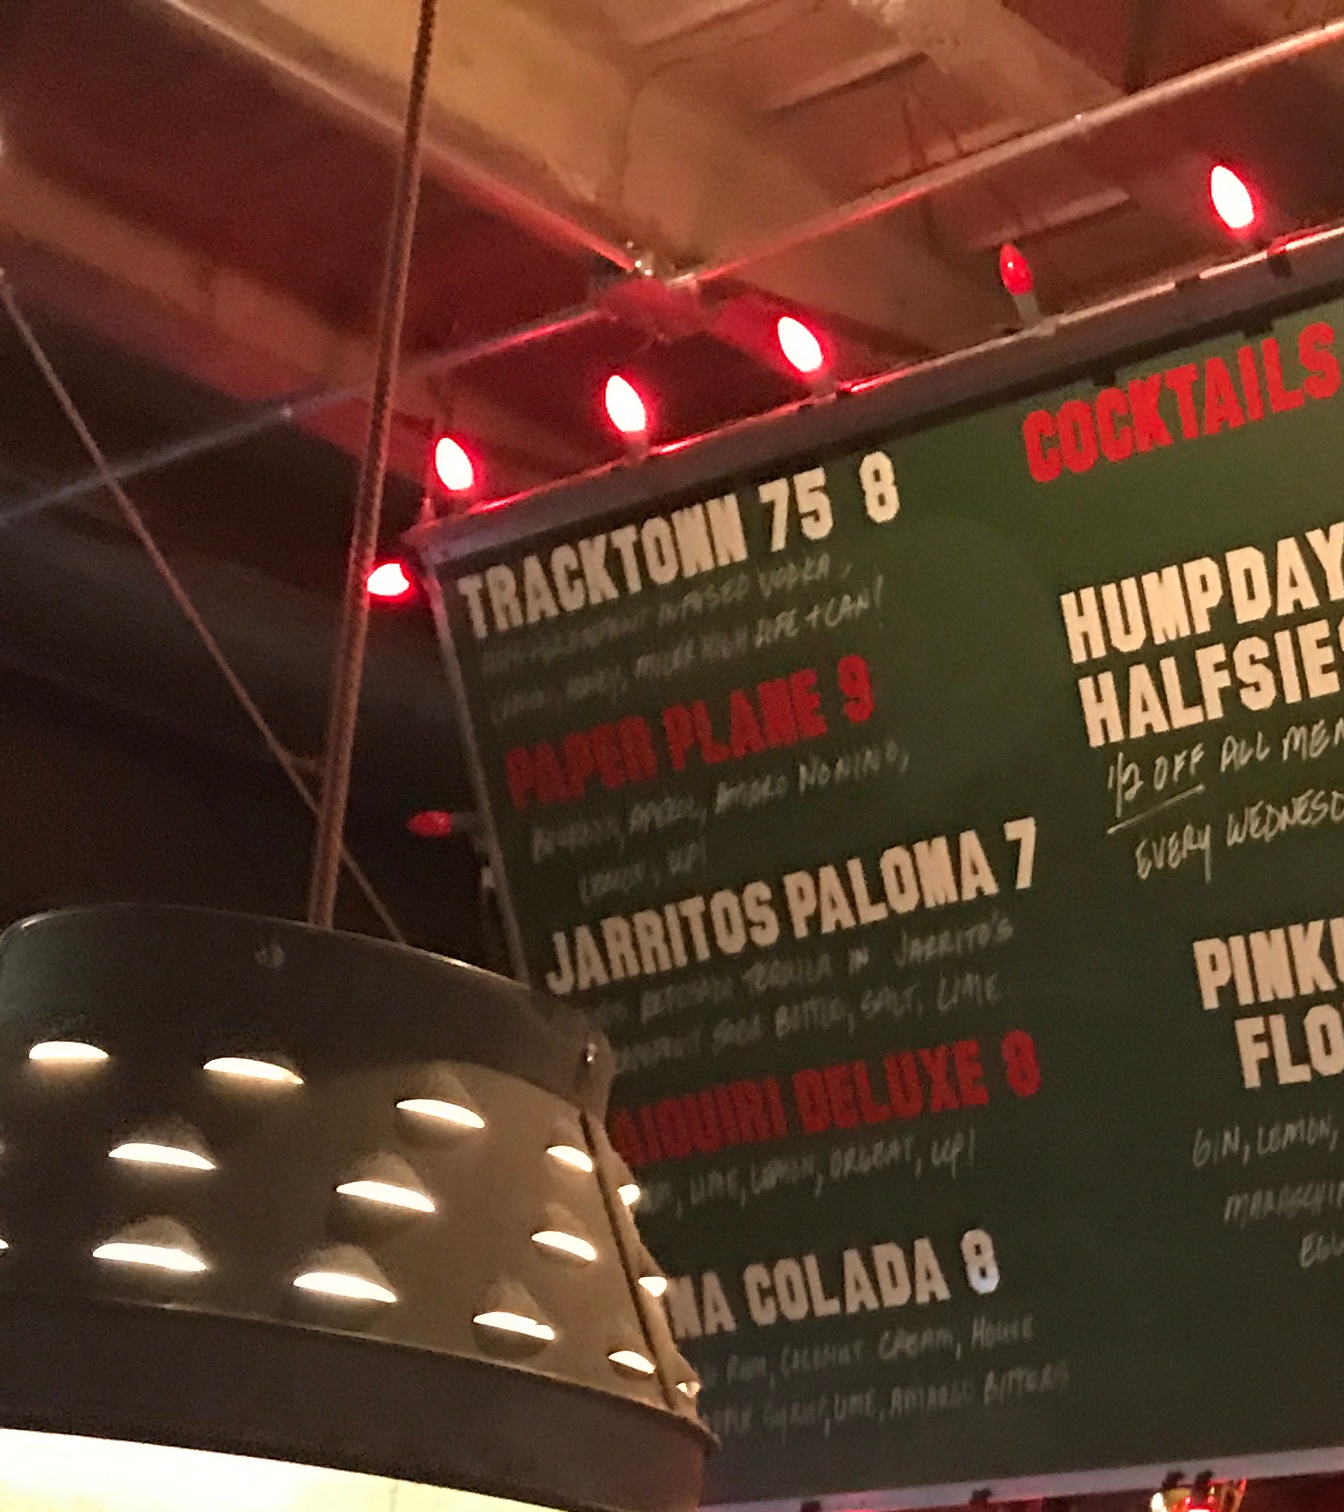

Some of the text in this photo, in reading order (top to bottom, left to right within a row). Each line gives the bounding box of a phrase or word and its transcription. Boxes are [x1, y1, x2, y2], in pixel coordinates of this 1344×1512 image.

[1022, 321, 1342, 482] COCKTAILS
[457, 450, 901, 639] TRACKTOWN 75 8
[505, 715, 658, 809] PAPER
[662, 668, 827, 772] PLANE
[837, 653, 875, 724] 9
[1219, 730, 1271, 772] ALL
[546, 882, 779, 996] JARRITOS
[783, 829, 999, 938] PALOMA
[1004, 816, 1036, 889] 7
[1134, 822, 1212, 883] EVERY
[609, 1076, 788, 1168] AIQUIRI
[793, 1039, 988, 1134] DELUXE
[1002, 1029, 1042, 1096] 8
[743, 1228, 999, 1327] COLADA 8
